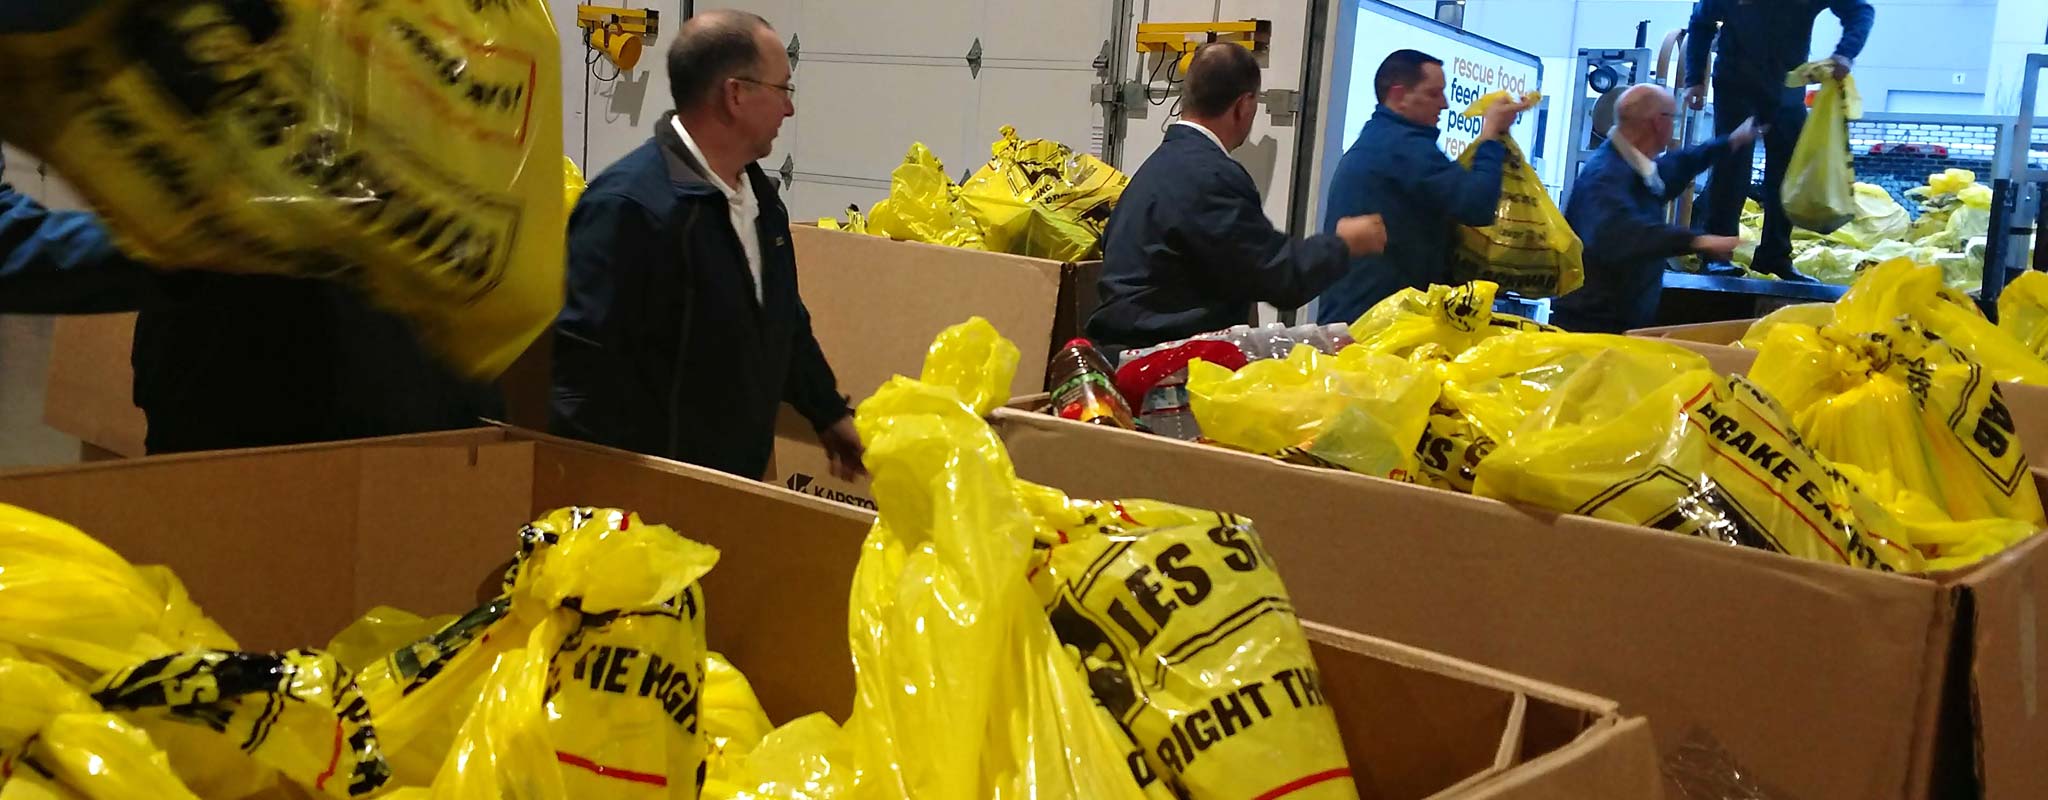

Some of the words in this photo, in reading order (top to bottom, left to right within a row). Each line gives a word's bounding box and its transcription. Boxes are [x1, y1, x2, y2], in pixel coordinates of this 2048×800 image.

[1453, 57, 1494, 85] rescue
[1451, 78, 1480, 105] feed
[1157, 682, 1272, 774] RIGHT
